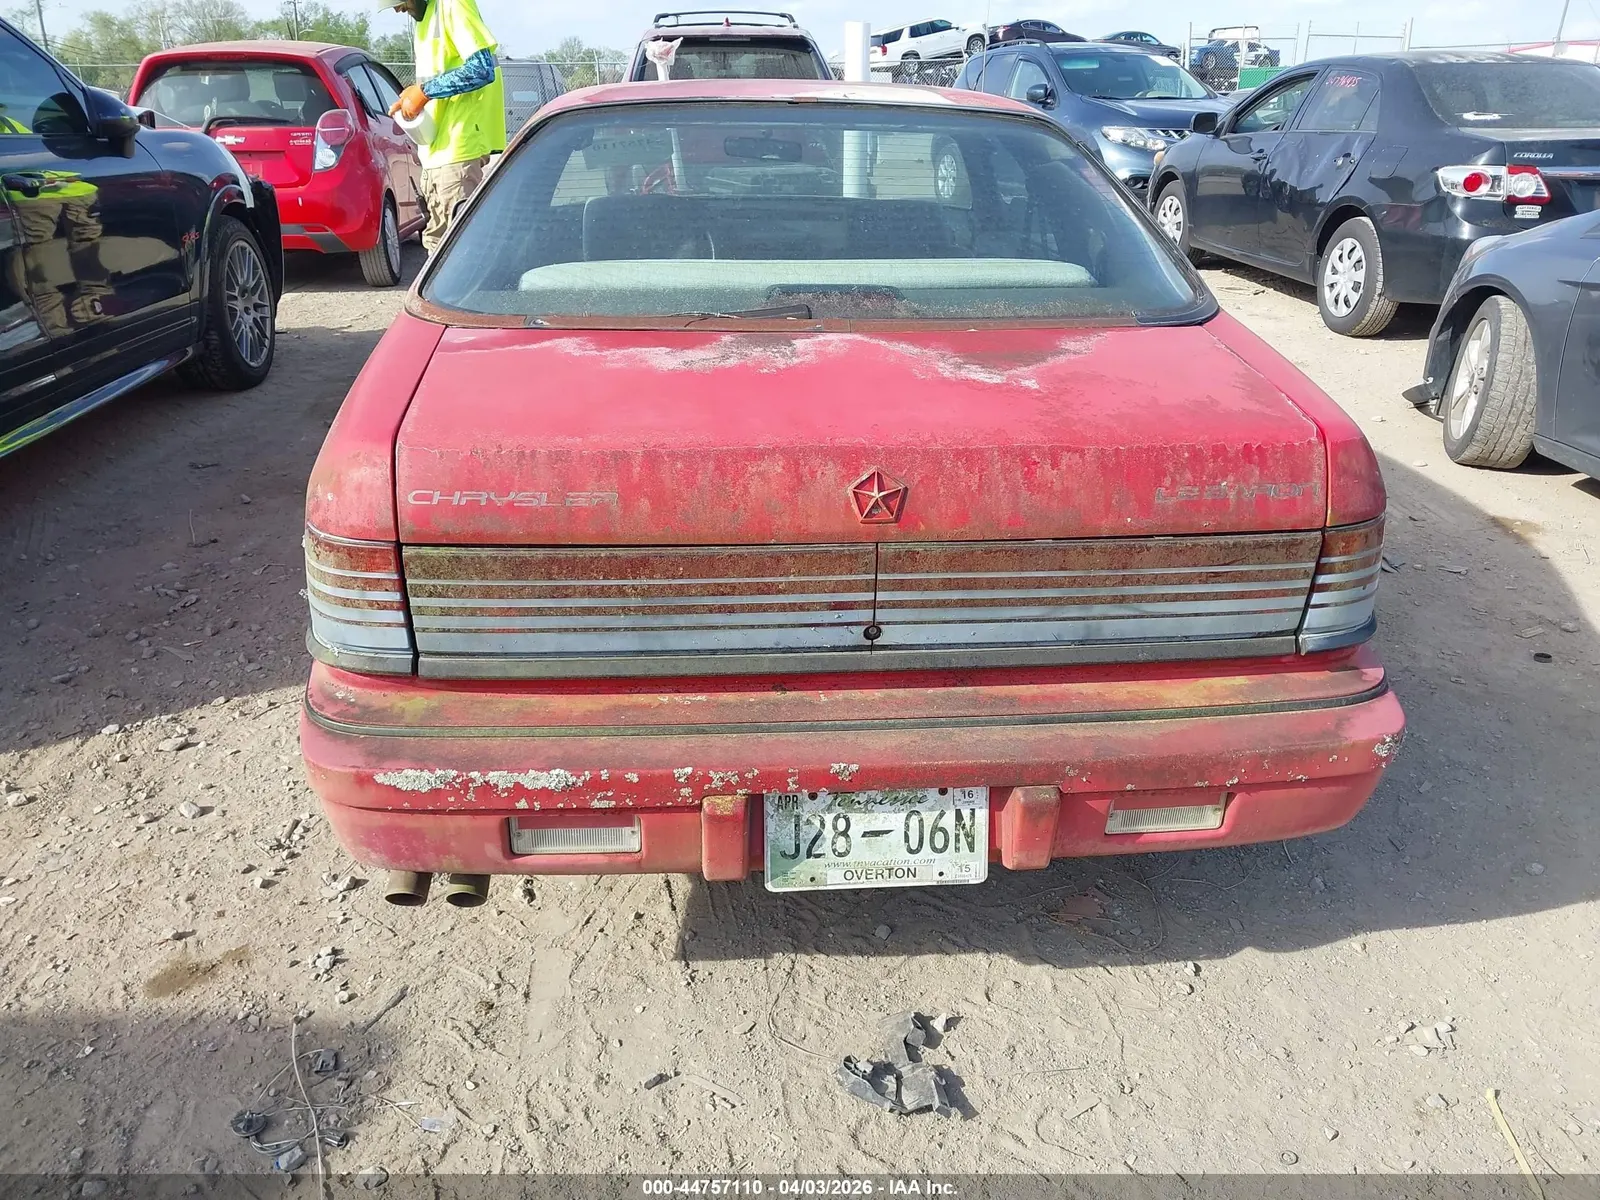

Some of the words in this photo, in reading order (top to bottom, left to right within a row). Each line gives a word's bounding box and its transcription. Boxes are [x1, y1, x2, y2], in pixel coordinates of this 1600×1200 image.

[407, 489, 619, 507] CHRYSLER
[961, 789, 974, 800] 16
[777, 795, 799, 810] APR
[824, 857, 936, 869] www.tnvacation.com
[959, 862, 971, 873] 15
[843, 867, 917, 881] OVERTON
